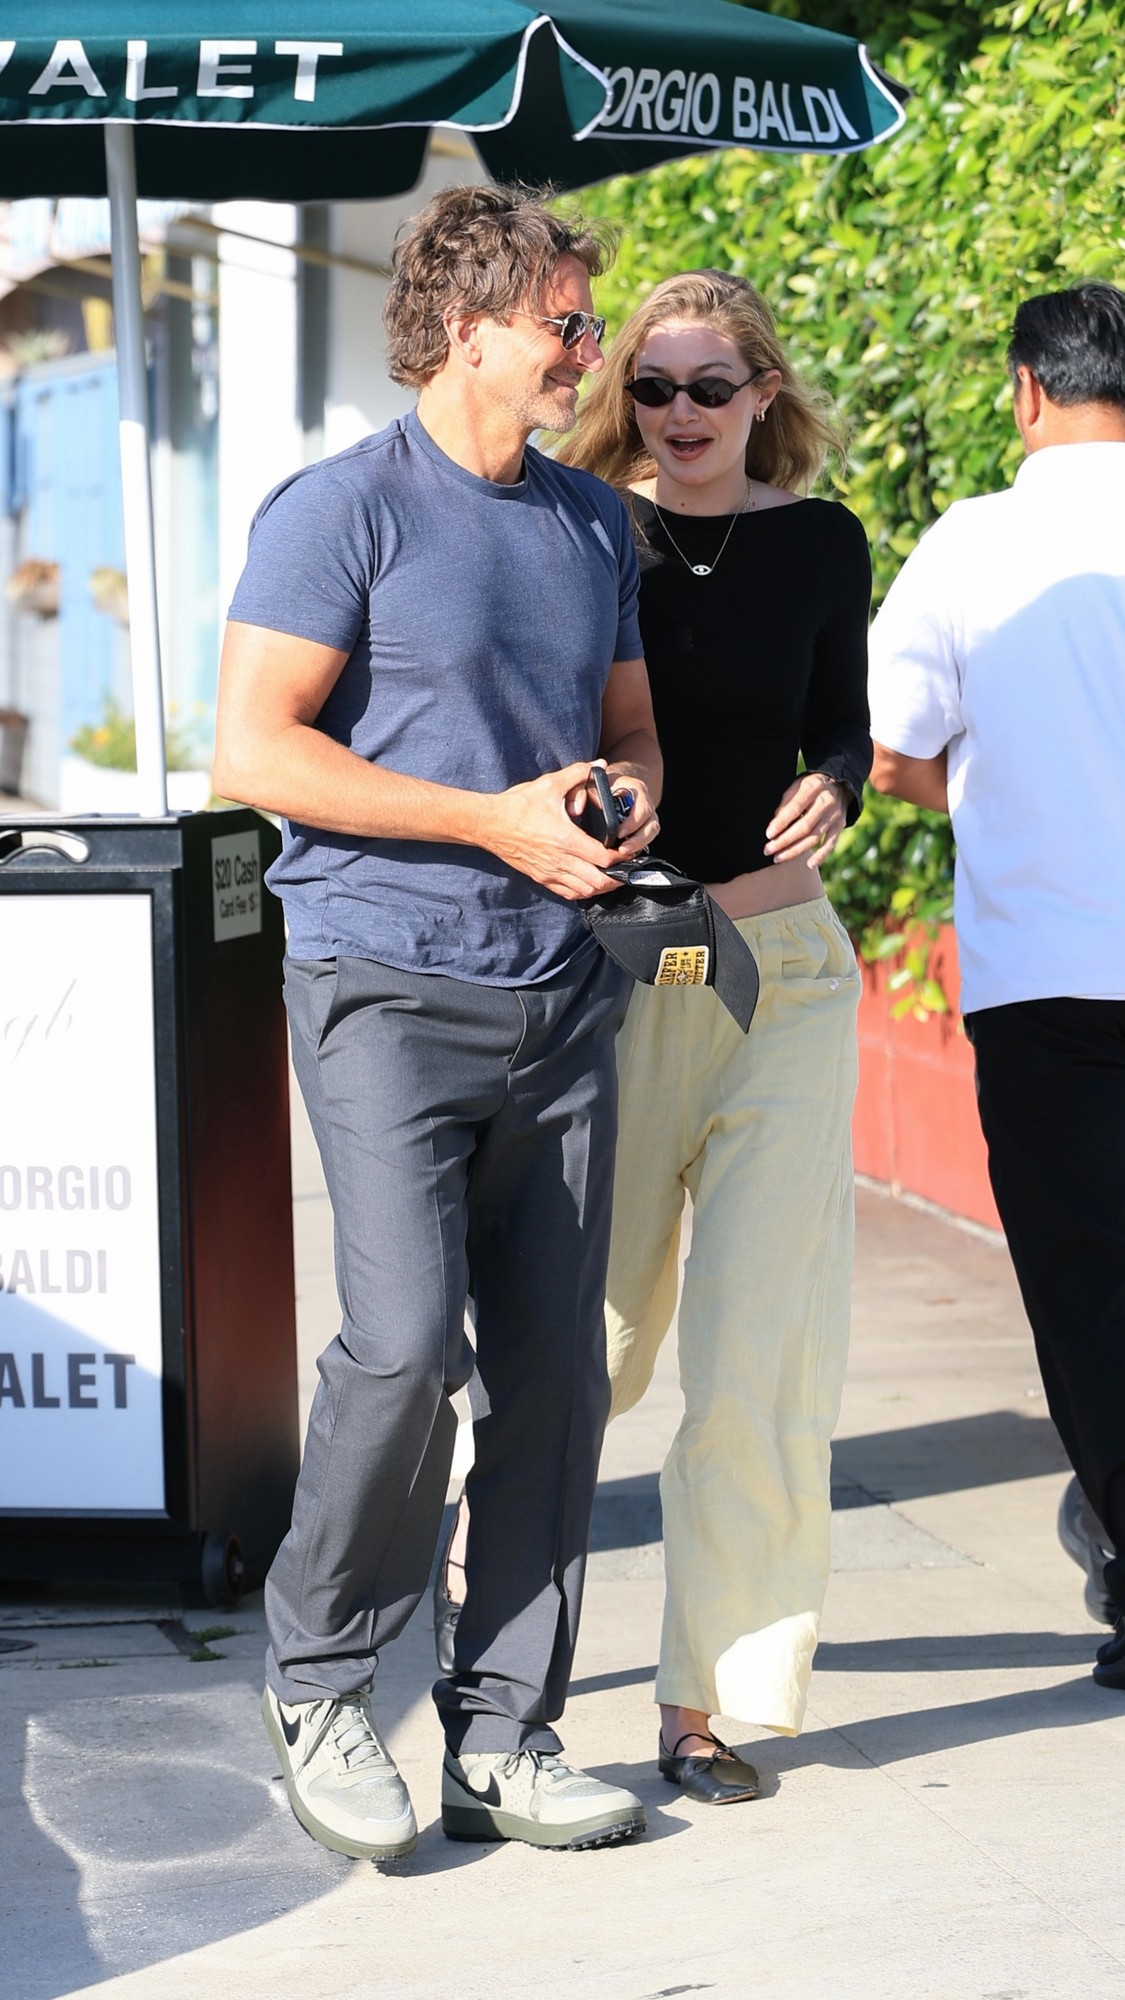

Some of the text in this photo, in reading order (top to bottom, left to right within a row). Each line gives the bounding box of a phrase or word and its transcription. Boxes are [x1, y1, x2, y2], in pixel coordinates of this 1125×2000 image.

[600, 66, 860, 143] ORGIO BALDI
[215, 852, 258, 894] $20 Cash
[0, 1249, 107, 1294] ALDI
